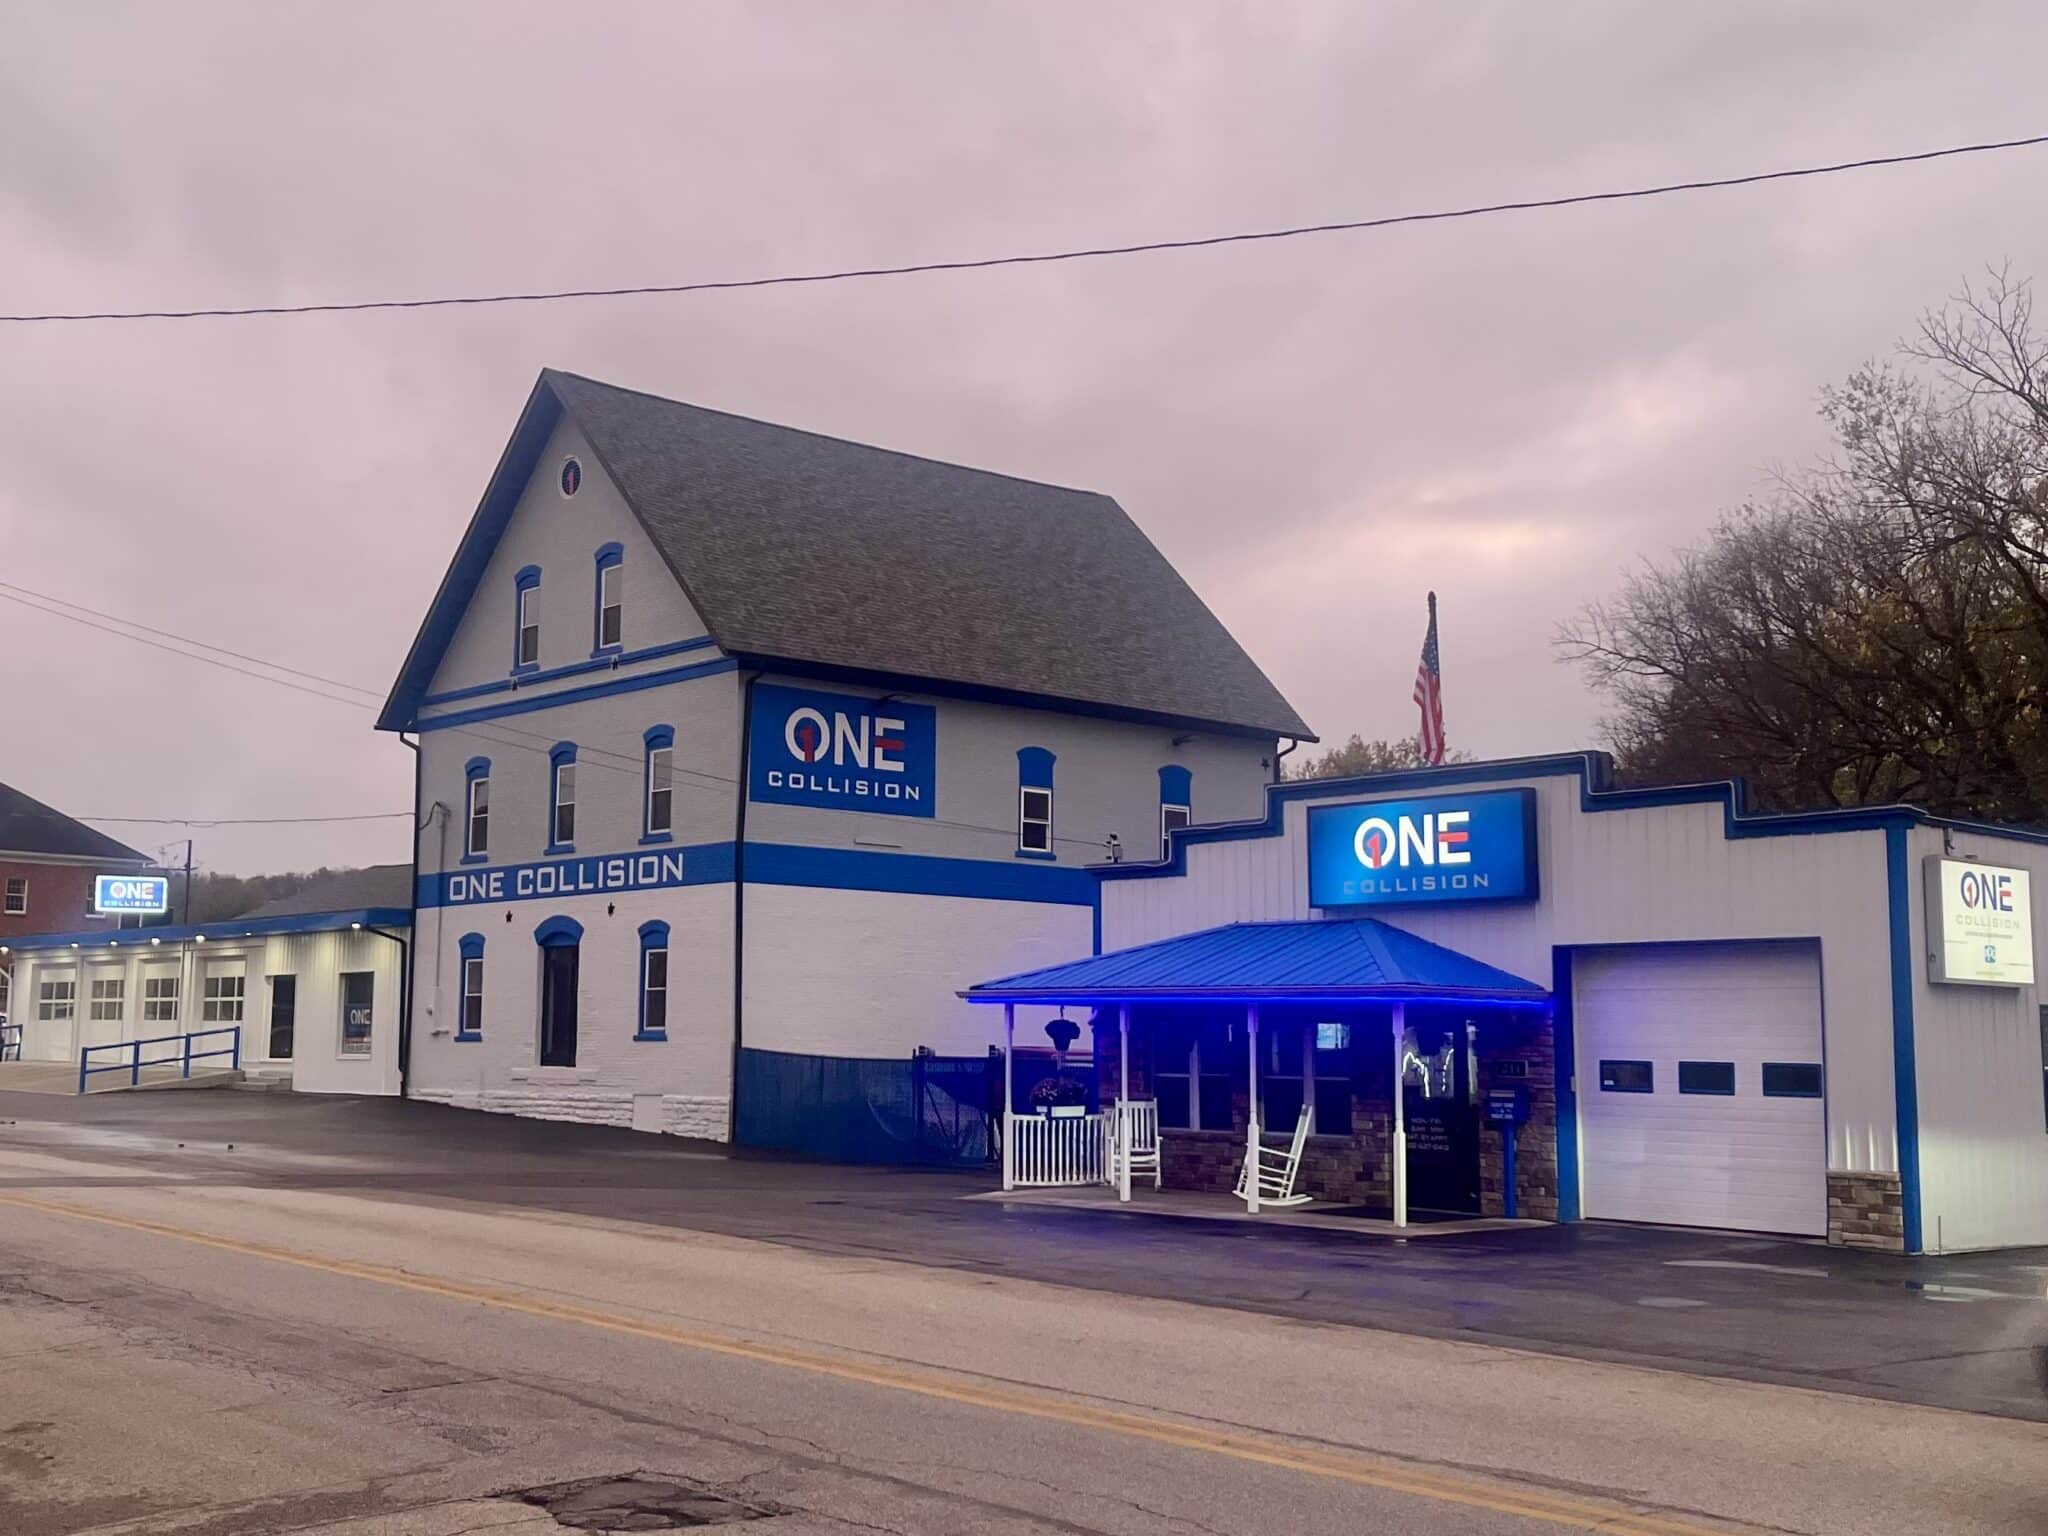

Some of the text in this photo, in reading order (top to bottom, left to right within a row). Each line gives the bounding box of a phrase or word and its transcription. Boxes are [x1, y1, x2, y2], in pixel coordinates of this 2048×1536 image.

[785, 707, 905, 773] ONE
[768, 771, 920, 801] COLLISION
[1354, 811, 1471, 869] ONE
[110, 881, 154, 900] ONE
[449, 853, 684, 901] ONE COLLISION
[1343, 873, 1489, 895] COLLISION
[1960, 871, 2013, 912] ONE
[1955, 914, 2020, 929] COLLISION
[350, 1008, 371, 1025] ONE
